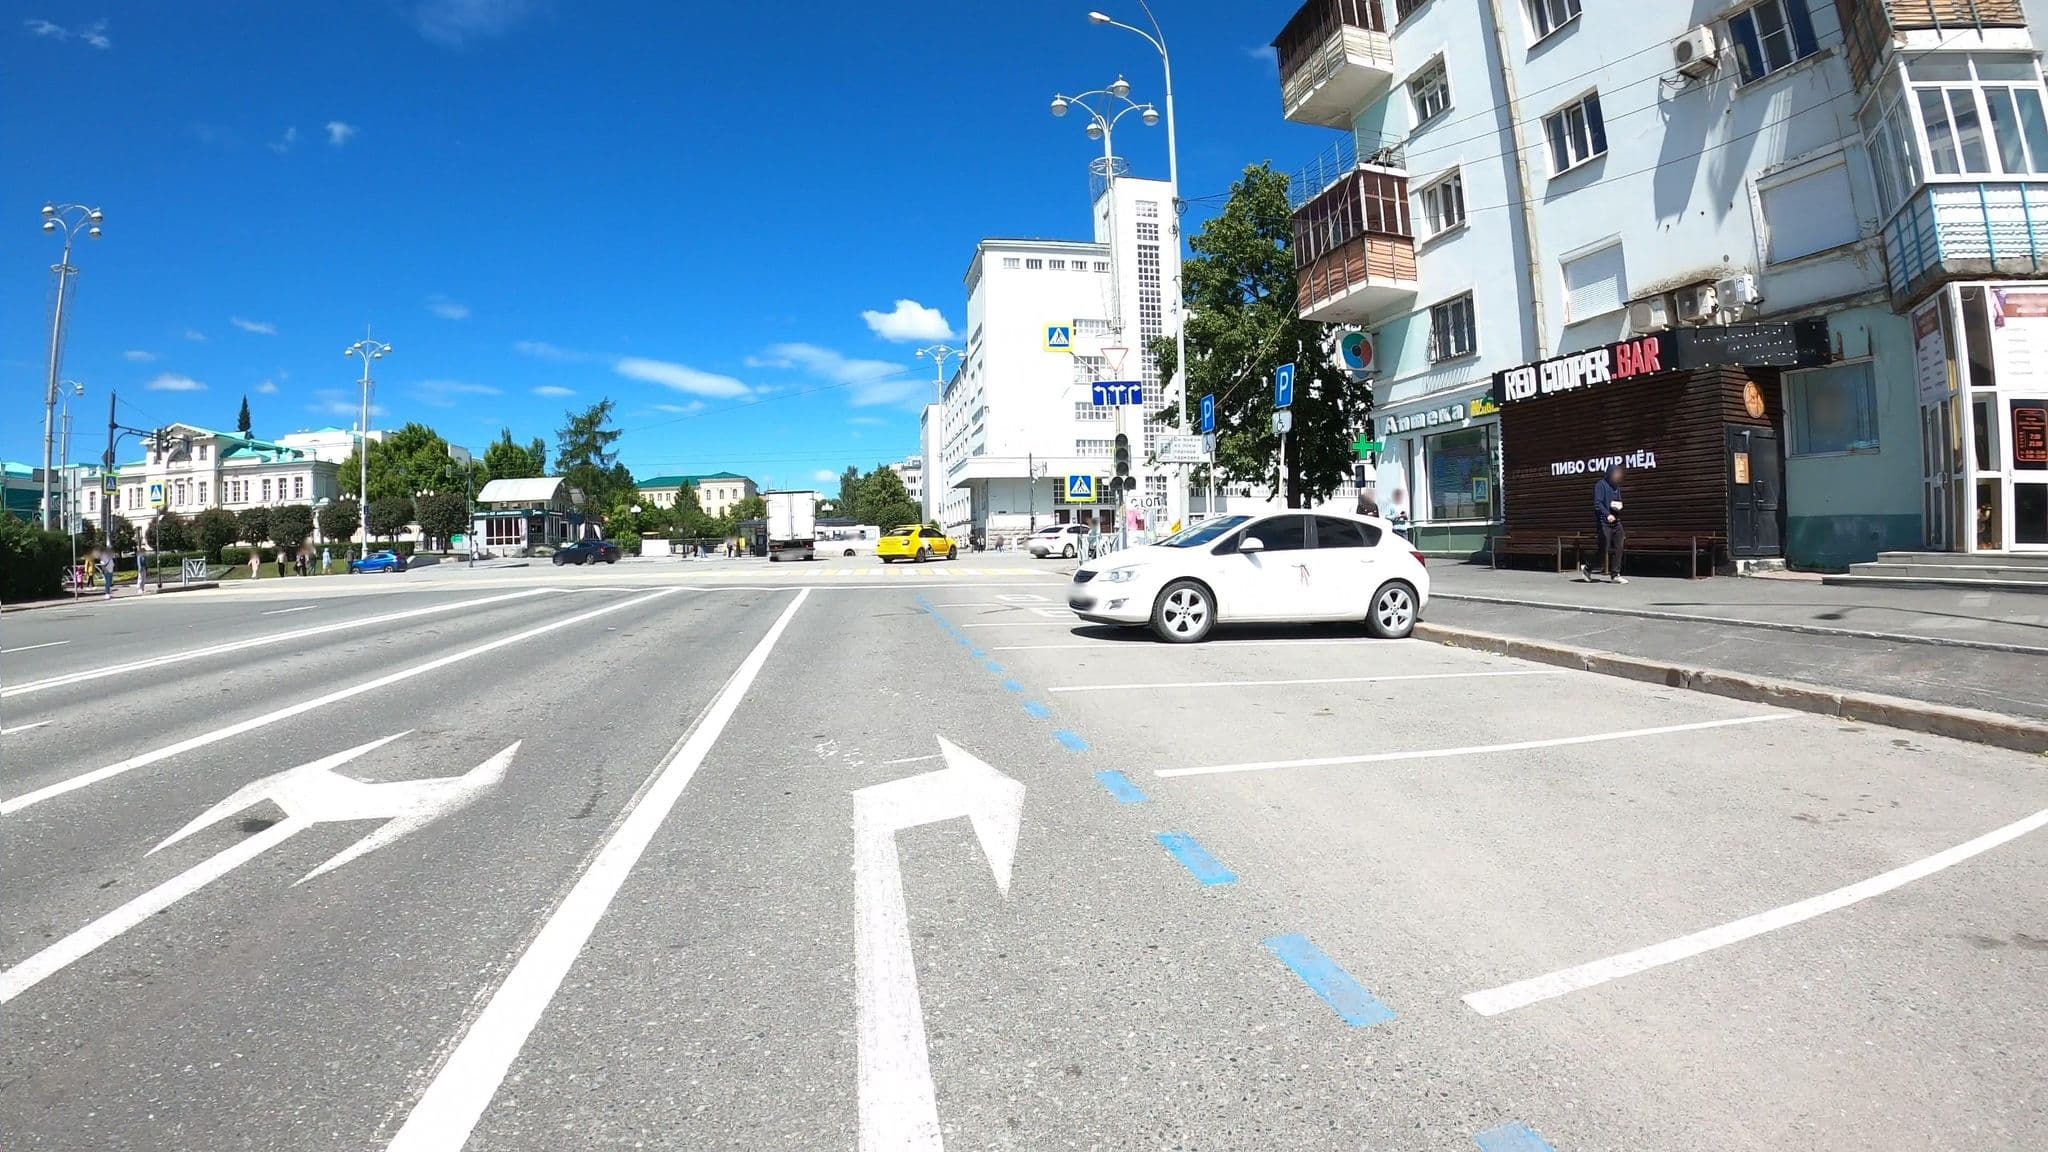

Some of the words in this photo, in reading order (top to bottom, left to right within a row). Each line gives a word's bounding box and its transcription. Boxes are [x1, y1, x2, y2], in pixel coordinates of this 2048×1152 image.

[1279, 371, 1289, 402] P
[1504, 366, 1537, 401] RED
[1540, 348, 1611, 394] COOPER
[1203, 400, 1212, 428] P
[1385, 403, 1465, 435] Аптека
[1551, 459, 1585, 476] ПИВО
[1625, 449, 1657, 469] МЁД
